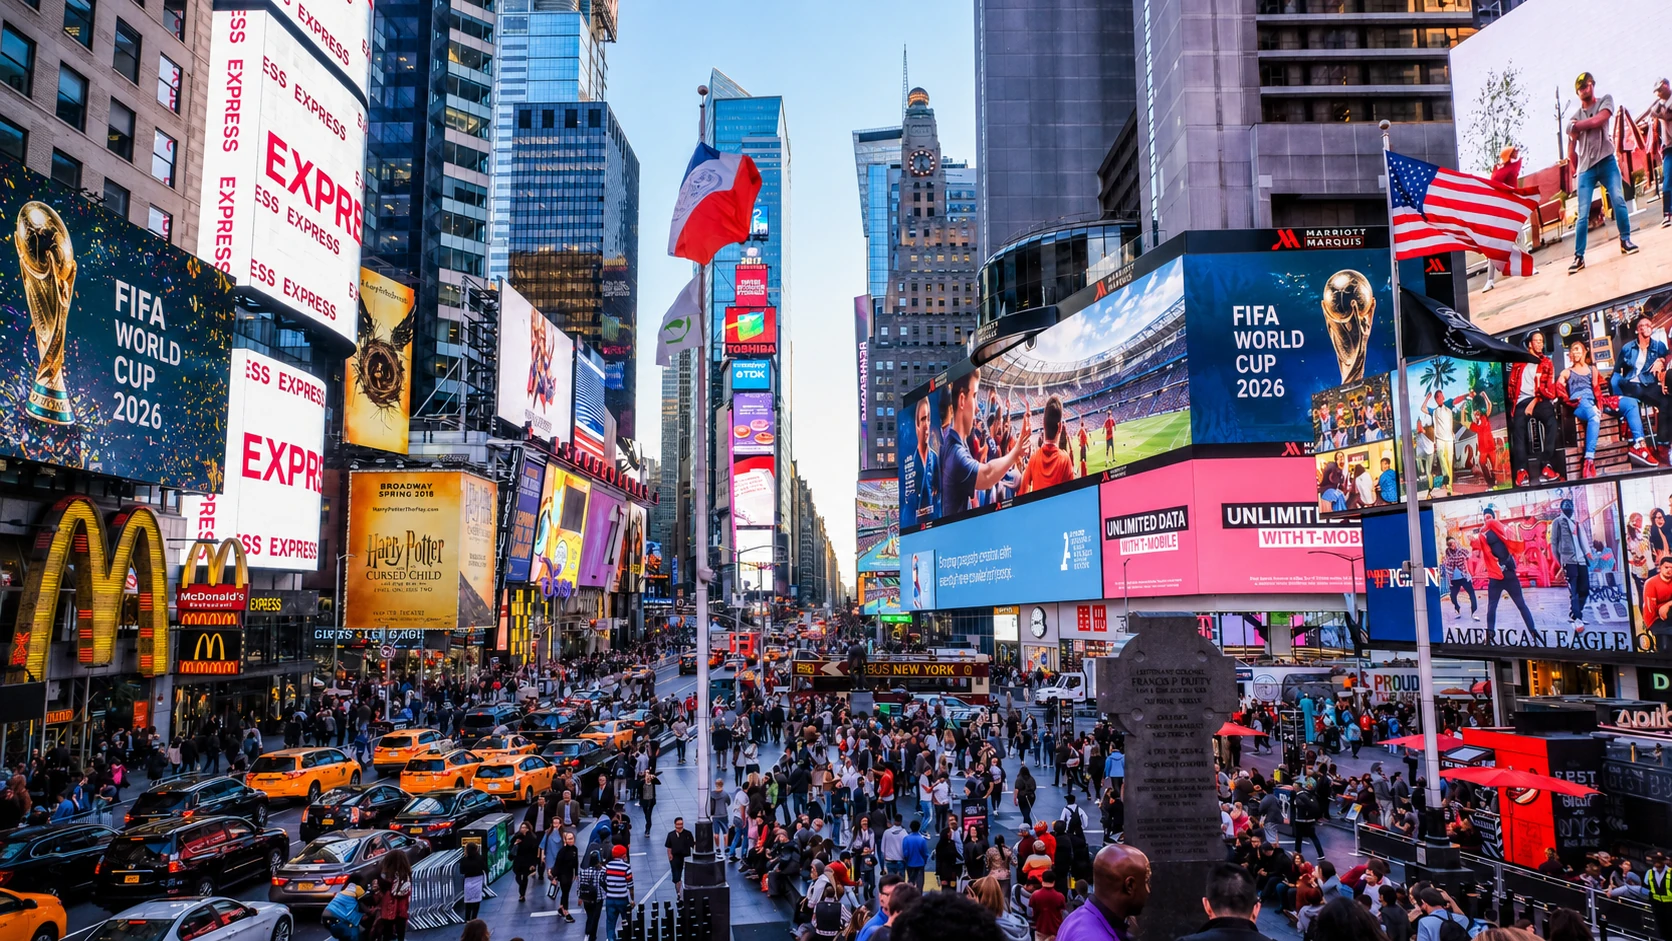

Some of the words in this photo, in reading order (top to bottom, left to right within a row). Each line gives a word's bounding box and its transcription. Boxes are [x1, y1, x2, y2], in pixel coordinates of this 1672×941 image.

[298, 4, 349, 66] EXPRESS
[223, 60, 243, 152] EXPRESS
[294, 84, 346, 141] EXPRESS
[215, 177, 236, 273] EXPRESS
[287, 206, 340, 255] EXPRESS
[1306, 228, 1366, 237] MARRIOTT
[1307, 237, 1361, 247] MARQUIS
[115, 279, 166, 330] FIFA
[283, 278, 337, 320] EXPRESS
[1233, 305, 1280, 326] FIFA
[115, 320, 180, 366] WORLD
[1234, 330, 1305, 349] WORLD
[114, 355, 155, 391] CUP
[743, 370, 765, 378] TDK
[1236, 354, 1277, 373] CUP
[279, 371, 325, 408] EXPRESS
[1237, 378, 1285, 398] 2026
[113, 392, 162, 430] 2026
[1106, 515, 1157, 536] UNLIMITED
[1159, 510, 1186, 529] DATA
[270, 537, 317, 560] EXPRESS
[1121, 538, 1140, 553] WITH
[1140, 534, 1177, 551] T-MOBILE
[1262, 530, 1304, 545] WITH
[365, 533, 405, 569] Harry
[406, 530, 445, 572] Potter
[366, 571, 406, 580] CURSED
[409, 571, 442, 580] CHILD
[180, 592, 245, 601] McDonald's
[1445, 627, 1547, 648] AMERICAN
[1555, 629, 1630, 650] EAGLE
[867, 664, 890, 675] BUS
[893, 664, 920, 675] NEW
[924, 664, 955, 675] YORK
[1374, 674, 1420, 691] PROUD
